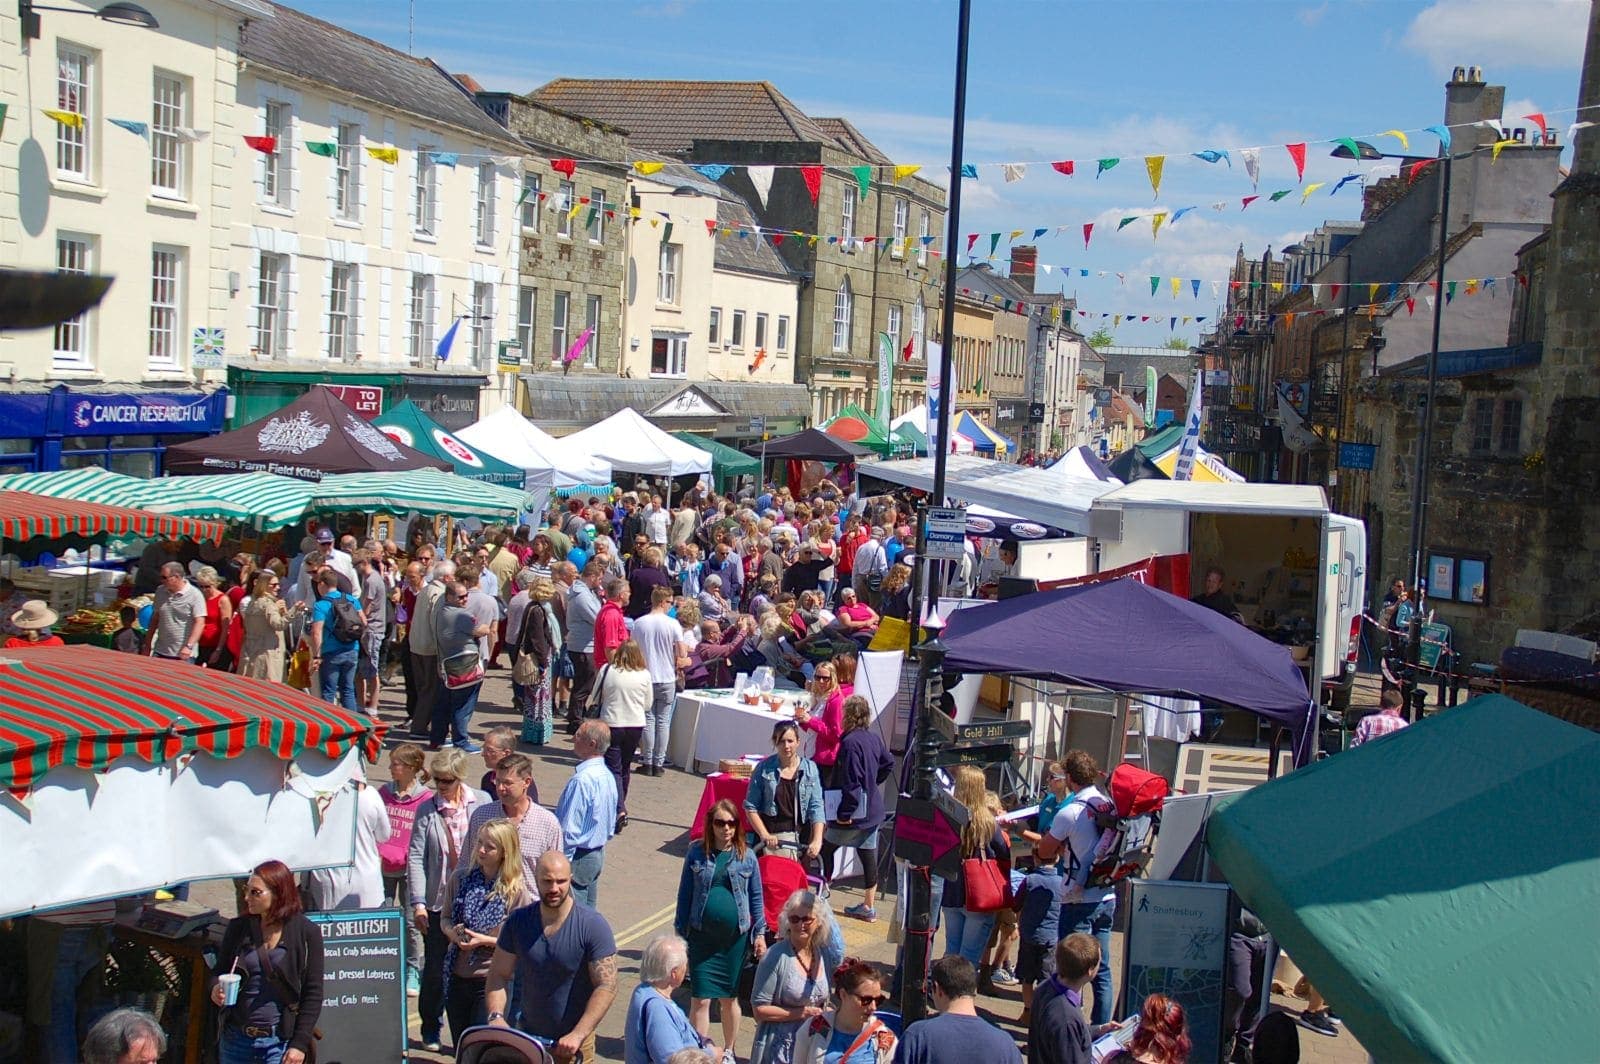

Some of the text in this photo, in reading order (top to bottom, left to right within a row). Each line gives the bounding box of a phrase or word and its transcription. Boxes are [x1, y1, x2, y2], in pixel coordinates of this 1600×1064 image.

[360, 391, 376, 400] TO
[356, 401, 378, 410] LET
[93, 405, 206, 422] CANCER RESEARCH UK
[239, 459, 266, 472] Farm
[268, 463, 294, 476] Field
[929, 532, 954, 541] Damory
[964, 726, 1003, 738] Gold Hill
[336, 919, 389, 937] SHELLFISH
[343, 946, 360, 957] Crab
[361, 946, 398, 956] Sandwiches
[339, 970, 366, 979] Dressed
[367, 970, 396, 980] Lobsters
[341, 994, 358, 1005] Crab
